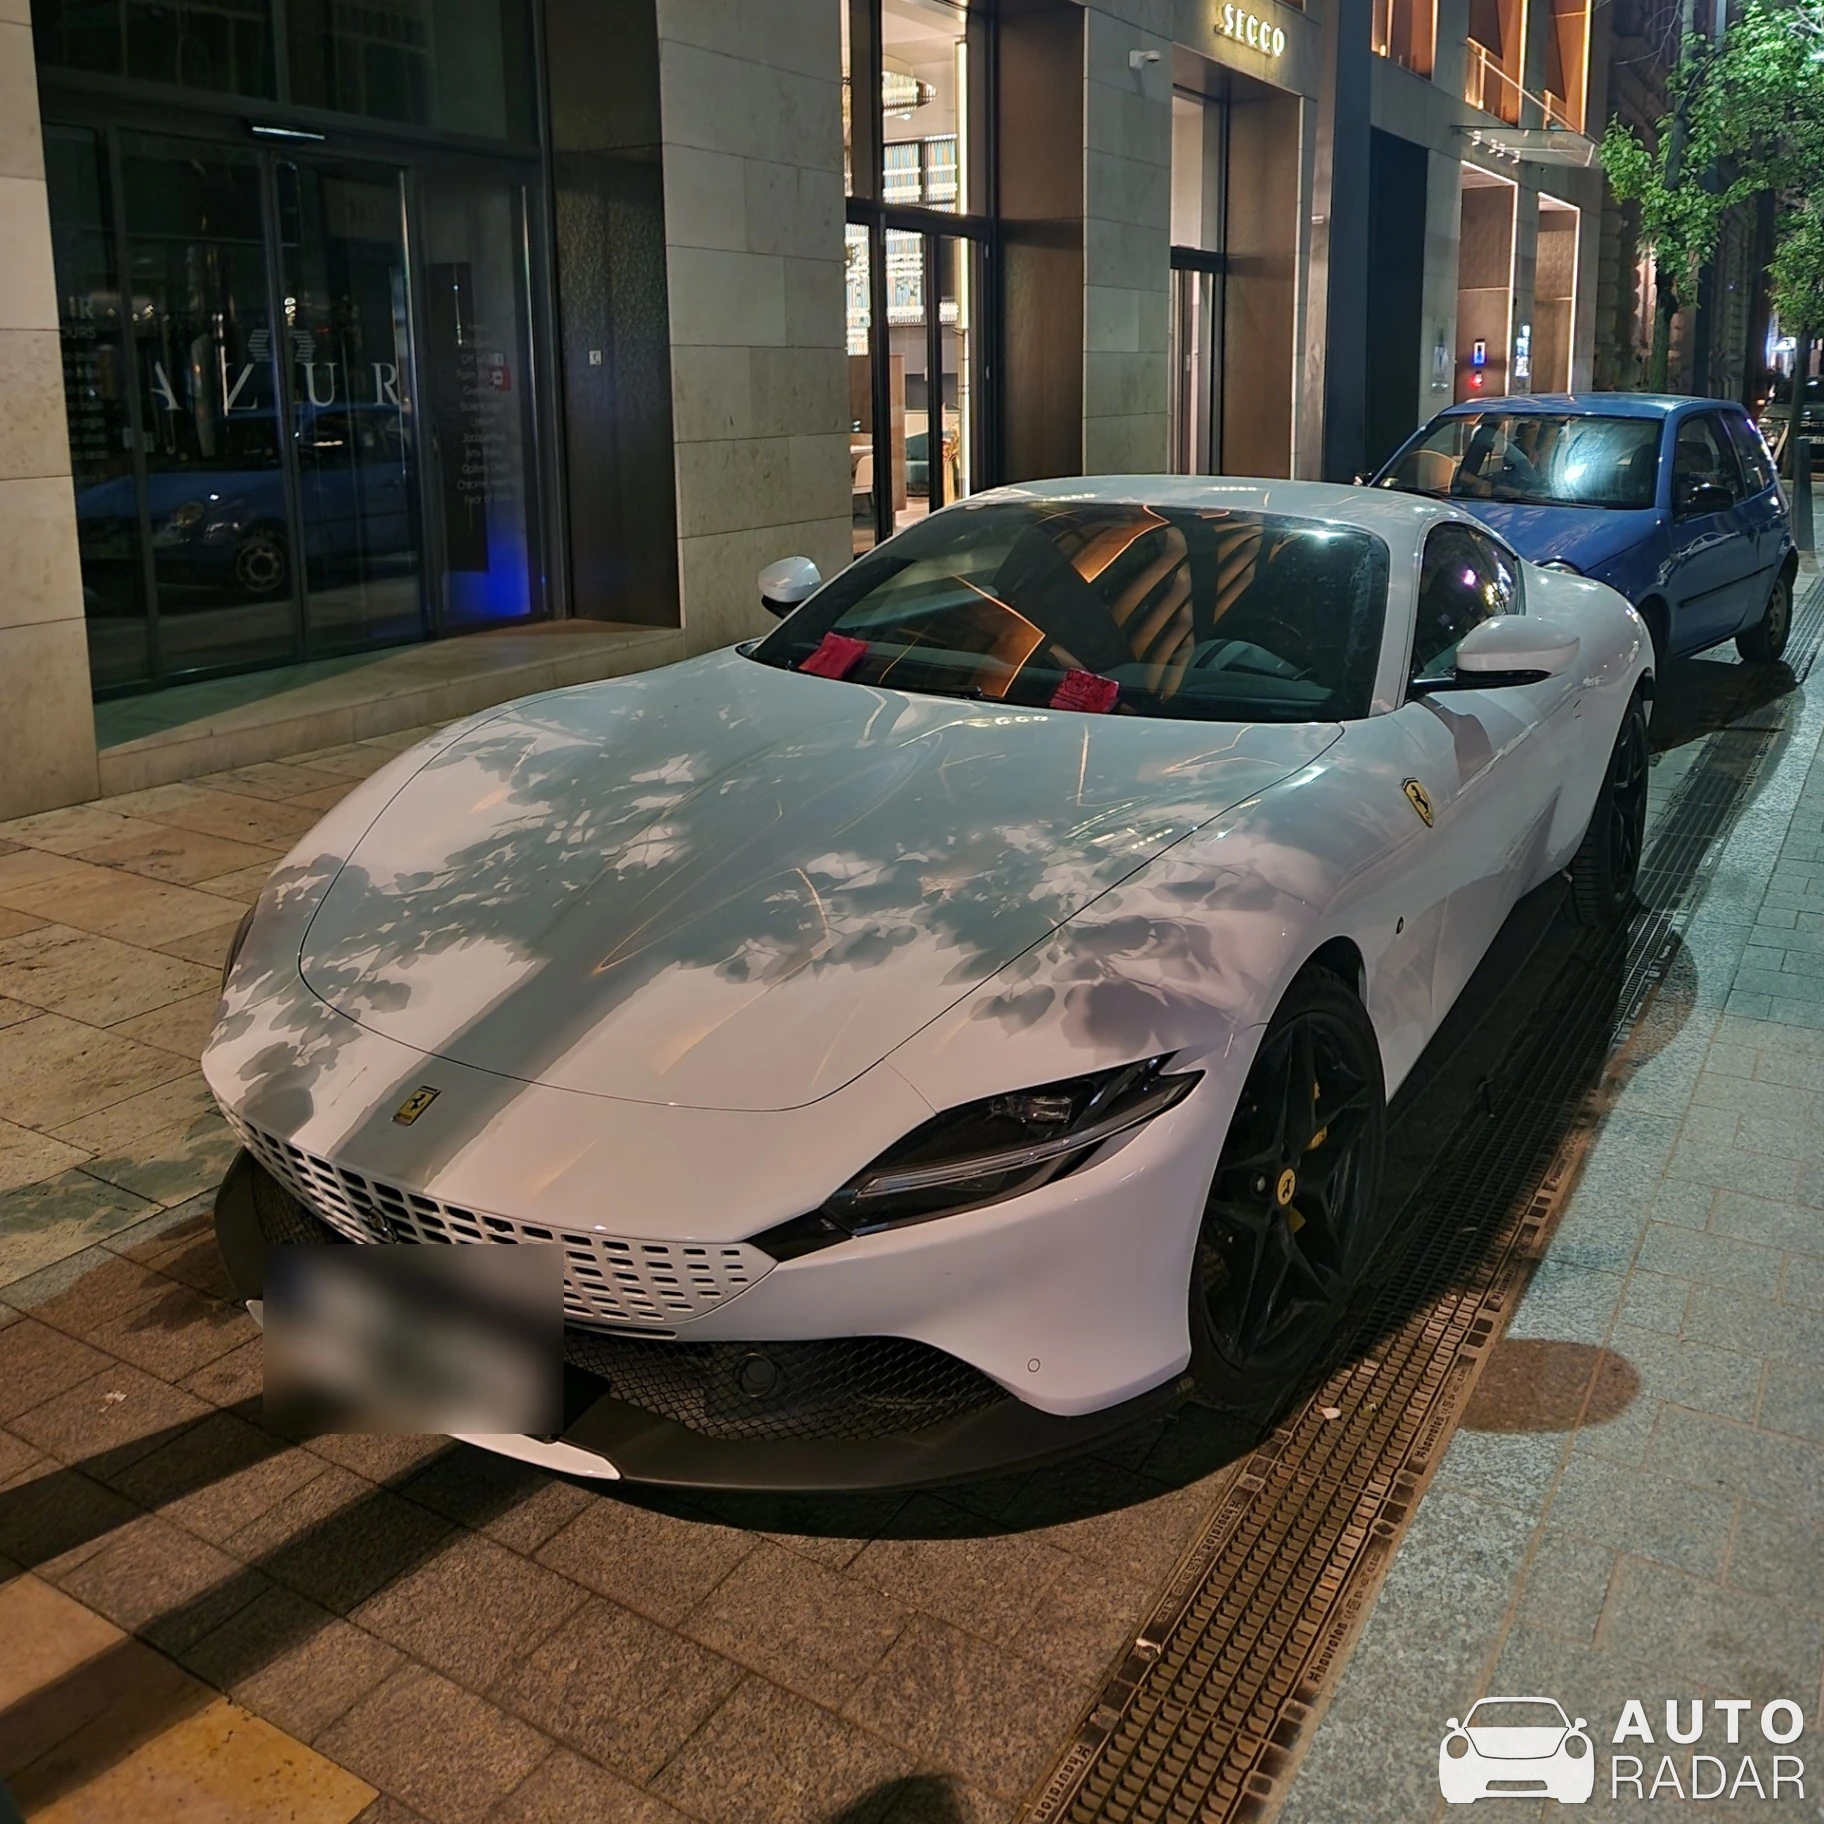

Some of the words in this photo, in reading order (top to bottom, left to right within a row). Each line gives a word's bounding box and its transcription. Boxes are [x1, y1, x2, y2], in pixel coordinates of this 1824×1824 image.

[1219, 2, 1285, 57] SECCO
[150, 360, 402, 410] AZUR
[1034, 1755, 1085, 1819] hauraton
